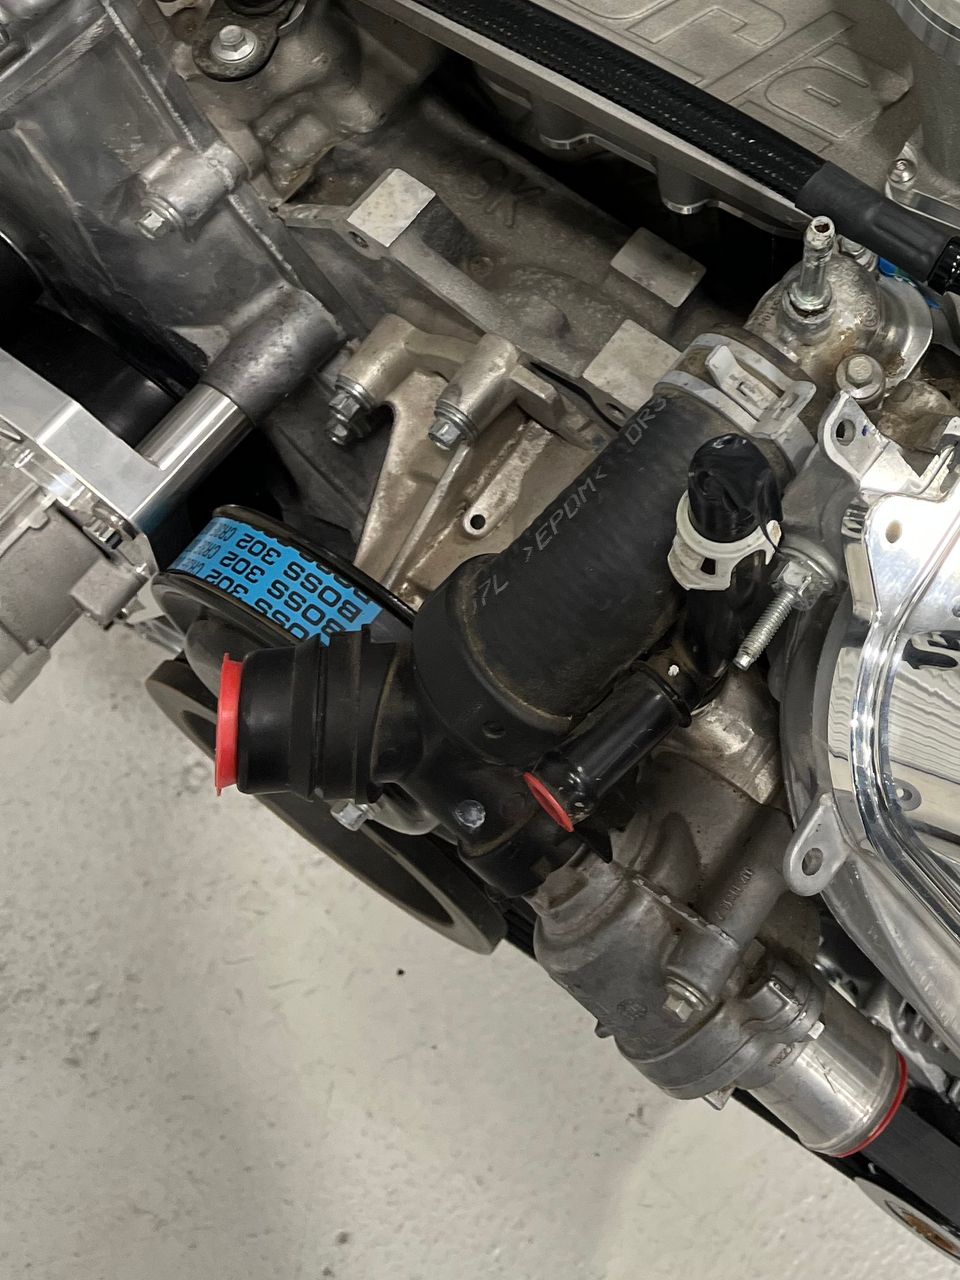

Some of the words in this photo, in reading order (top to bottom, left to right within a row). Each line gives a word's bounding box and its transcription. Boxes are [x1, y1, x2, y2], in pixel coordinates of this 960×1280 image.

[235, 533, 282, 566] 302
[219, 550, 266, 584] 302
[283, 561, 363, 623] BOSS
